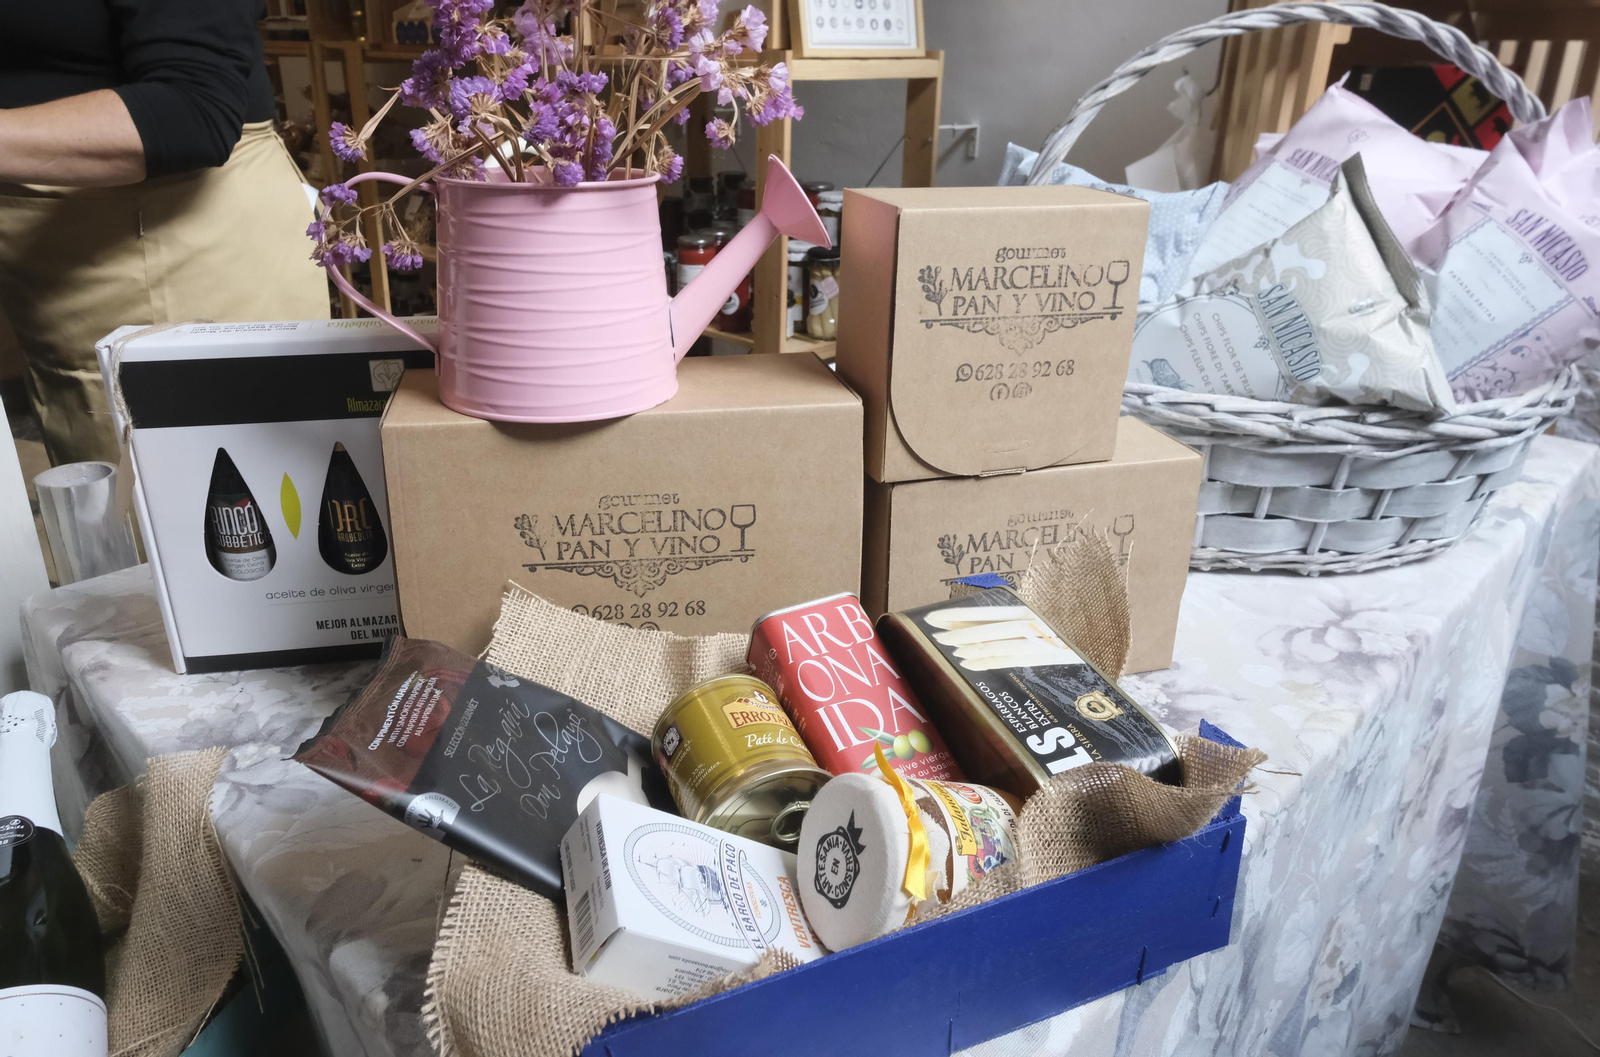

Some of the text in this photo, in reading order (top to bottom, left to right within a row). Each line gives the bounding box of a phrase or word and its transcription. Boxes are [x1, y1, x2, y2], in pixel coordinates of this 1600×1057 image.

[995, 247, 1066, 263] gourmet
[1506, 208, 1588, 282] SAN NICASIO
[949, 264, 1104, 291] MARCELINO
[952, 291, 1096, 316] PAN Y VINO
[1257, 284, 1298, 320] SAN
[1448, 270, 1475, 299] PATATAS
[1474, 298, 1497, 322] FRITAS
[1180, 324, 1212, 389] CHIPS FLEUR DE
[1193, 313, 1206, 336] CHIPS
[1204, 335, 1217, 362] FIORE
[1214, 361, 1224, 374] DI
[1212, 313, 1225, 338] CHIPS
[1222, 336, 1235, 361] FLOR
[1233, 360, 1243, 374] DE
[1270, 312, 1322, 382] NICASIO
[975, 359, 1075, 381] 628 28 92 68
[598, 493, 680, 510] gourmet
[551, 508, 727, 537] MARCELINO
[556, 535, 721, 561] PAN Y VINO
[969, 552, 1014, 574] PAN
[265, 589, 306, 600] aceite
[310, 587, 325, 597] de
[329, 585, 356, 595] oliva
[316, 615, 397, 630] MEJOR ALMAZAR
[591, 600, 706, 622] 628 28 92 68
[350, 629, 369, 640] DEL
[387, 678, 425, 743] WITH SMOKED PAPRIKA
[414, 726, 424, 737] AU
[420, 705, 435, 727] PAPRIKA
[815, 686, 929, 753] IDA
[975, 681, 1027, 733] ESPÁRRAGOS
[999, 691, 1039, 730] BLANCOS
[1024, 699, 1051, 726] EXTRA
[368, 736, 381, 751] CON
[378, 700, 399, 740] PIMENTÓN
[396, 734, 409, 747] CON
[404, 709, 420, 735] PAPRIKA
[444, 725, 466, 758] SELECCIÓN
[744, 732, 775, 748] Paté
[776, 729, 788, 745] de
[1067, 723, 1103, 760] LA SIERRA
[920, 751, 951, 766] vierge
[1026, 726, 1094, 775] LS
[918, 769, 929, 777] au
[419, 795, 457, 810] HANDMADE
[459, 774, 501, 812] La
[520, 784, 561, 819] Don
[1001, 808, 1011, 816] DE
[596, 820, 608, 859] VENTRESCA
[601, 857, 609, 869] DE
[818, 836, 840, 895] ARTESANIA
[831, 858, 841, 876] EN
[835, 840, 854, 898] CONSERVA
[725, 843, 764, 950] EL BARCO DE PACO
[776, 876, 812, 949] VENTRESCA
